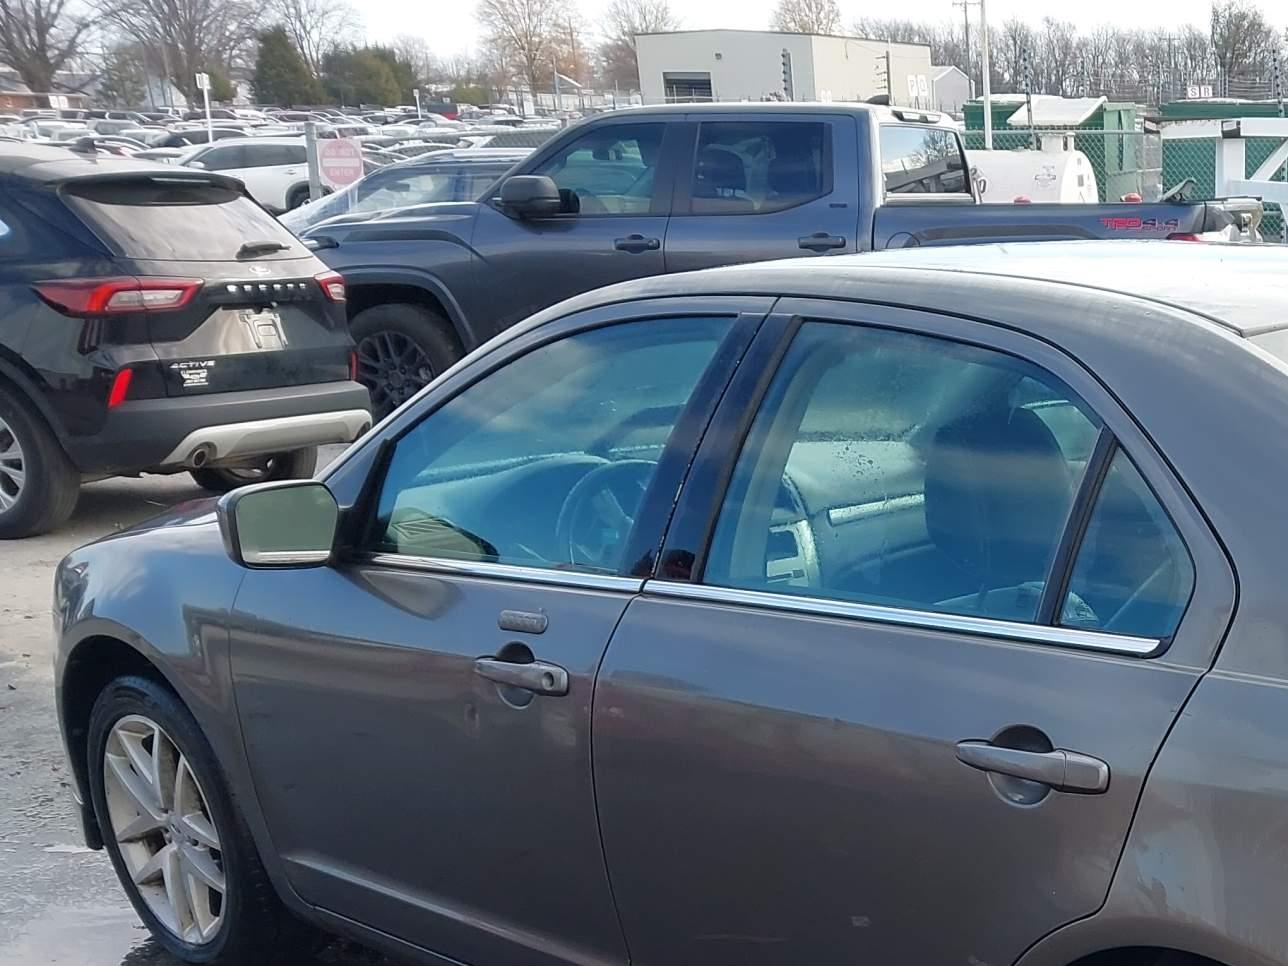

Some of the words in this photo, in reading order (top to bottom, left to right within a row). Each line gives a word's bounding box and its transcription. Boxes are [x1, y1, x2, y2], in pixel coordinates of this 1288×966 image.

[329, 167, 354, 177] ENTER
[1099, 217, 1142, 231] TRD
[169, 360, 216, 369] ACTIVE
